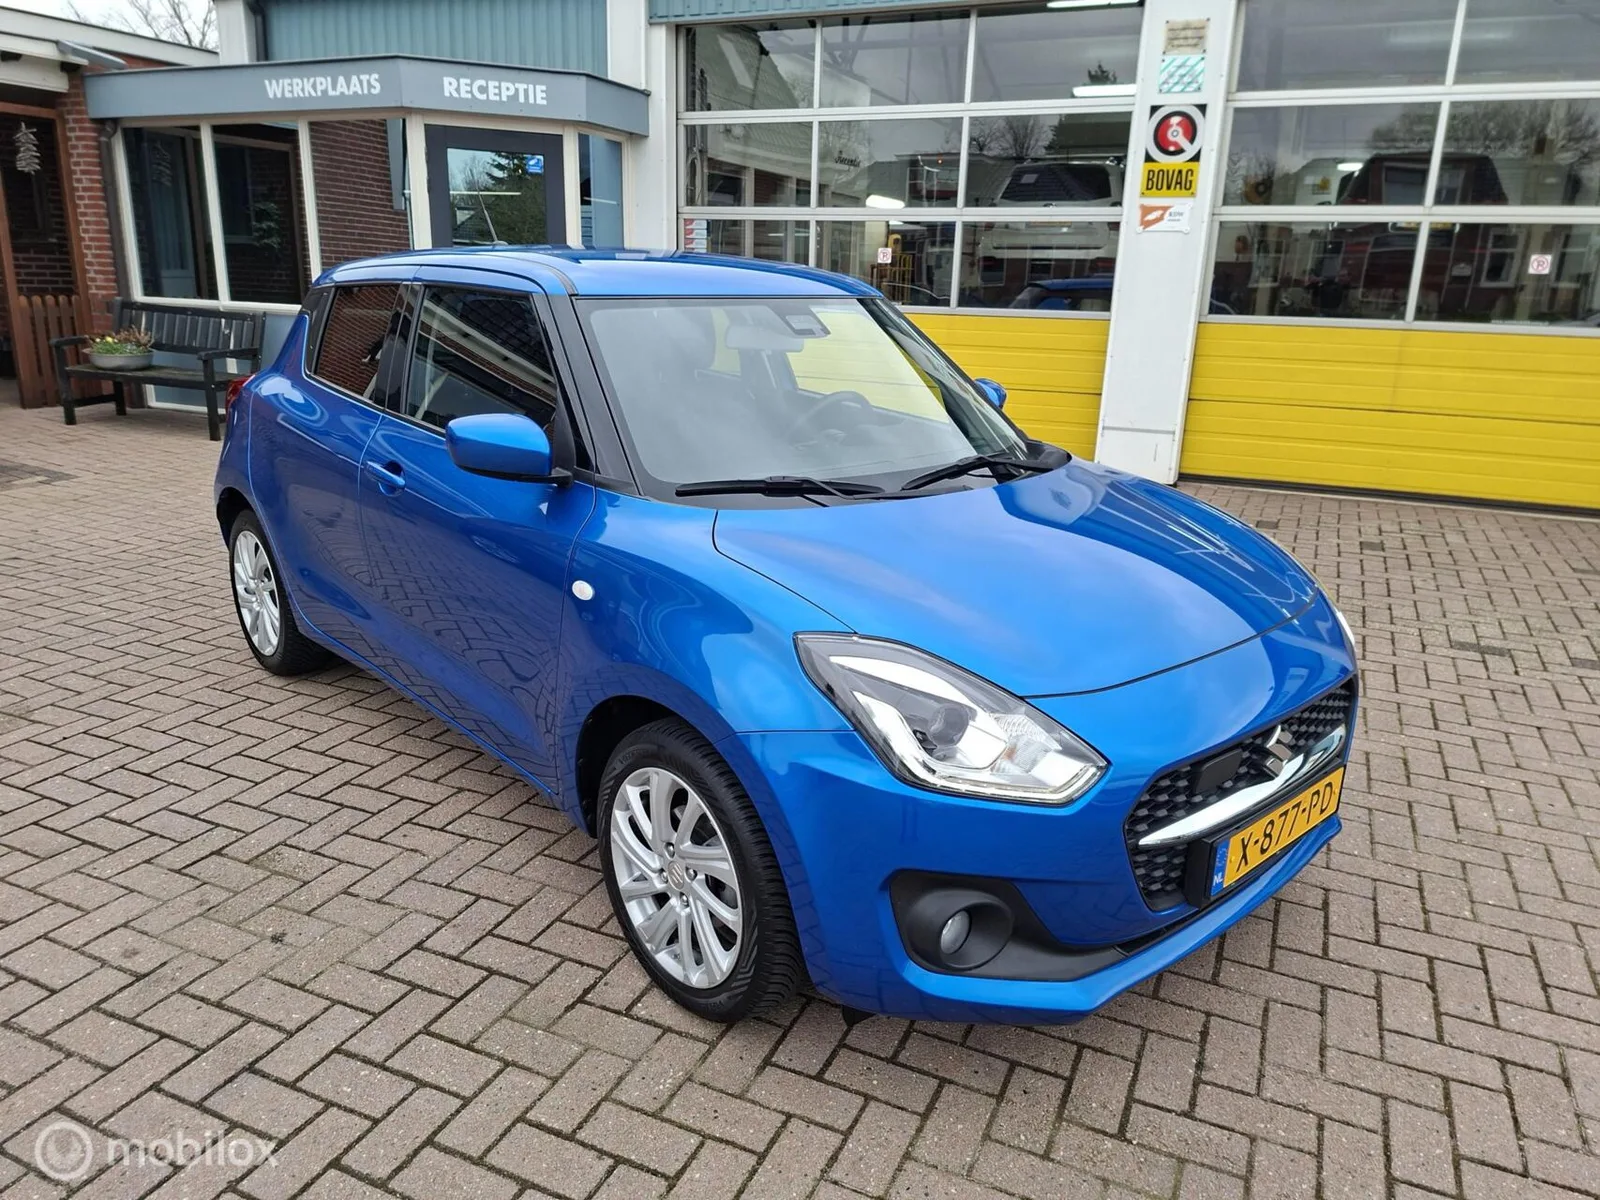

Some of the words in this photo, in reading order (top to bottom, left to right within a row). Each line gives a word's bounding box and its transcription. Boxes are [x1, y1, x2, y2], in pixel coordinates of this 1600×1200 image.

[264, 73, 381, 99] WERKPLAATS
[442, 76, 548, 106] RECEPTIE
[1145, 168, 1194, 191] BOVAG
[1236, 781, 1333, 874] X-877-PD
[1213, 873, 1224, 887] NL
